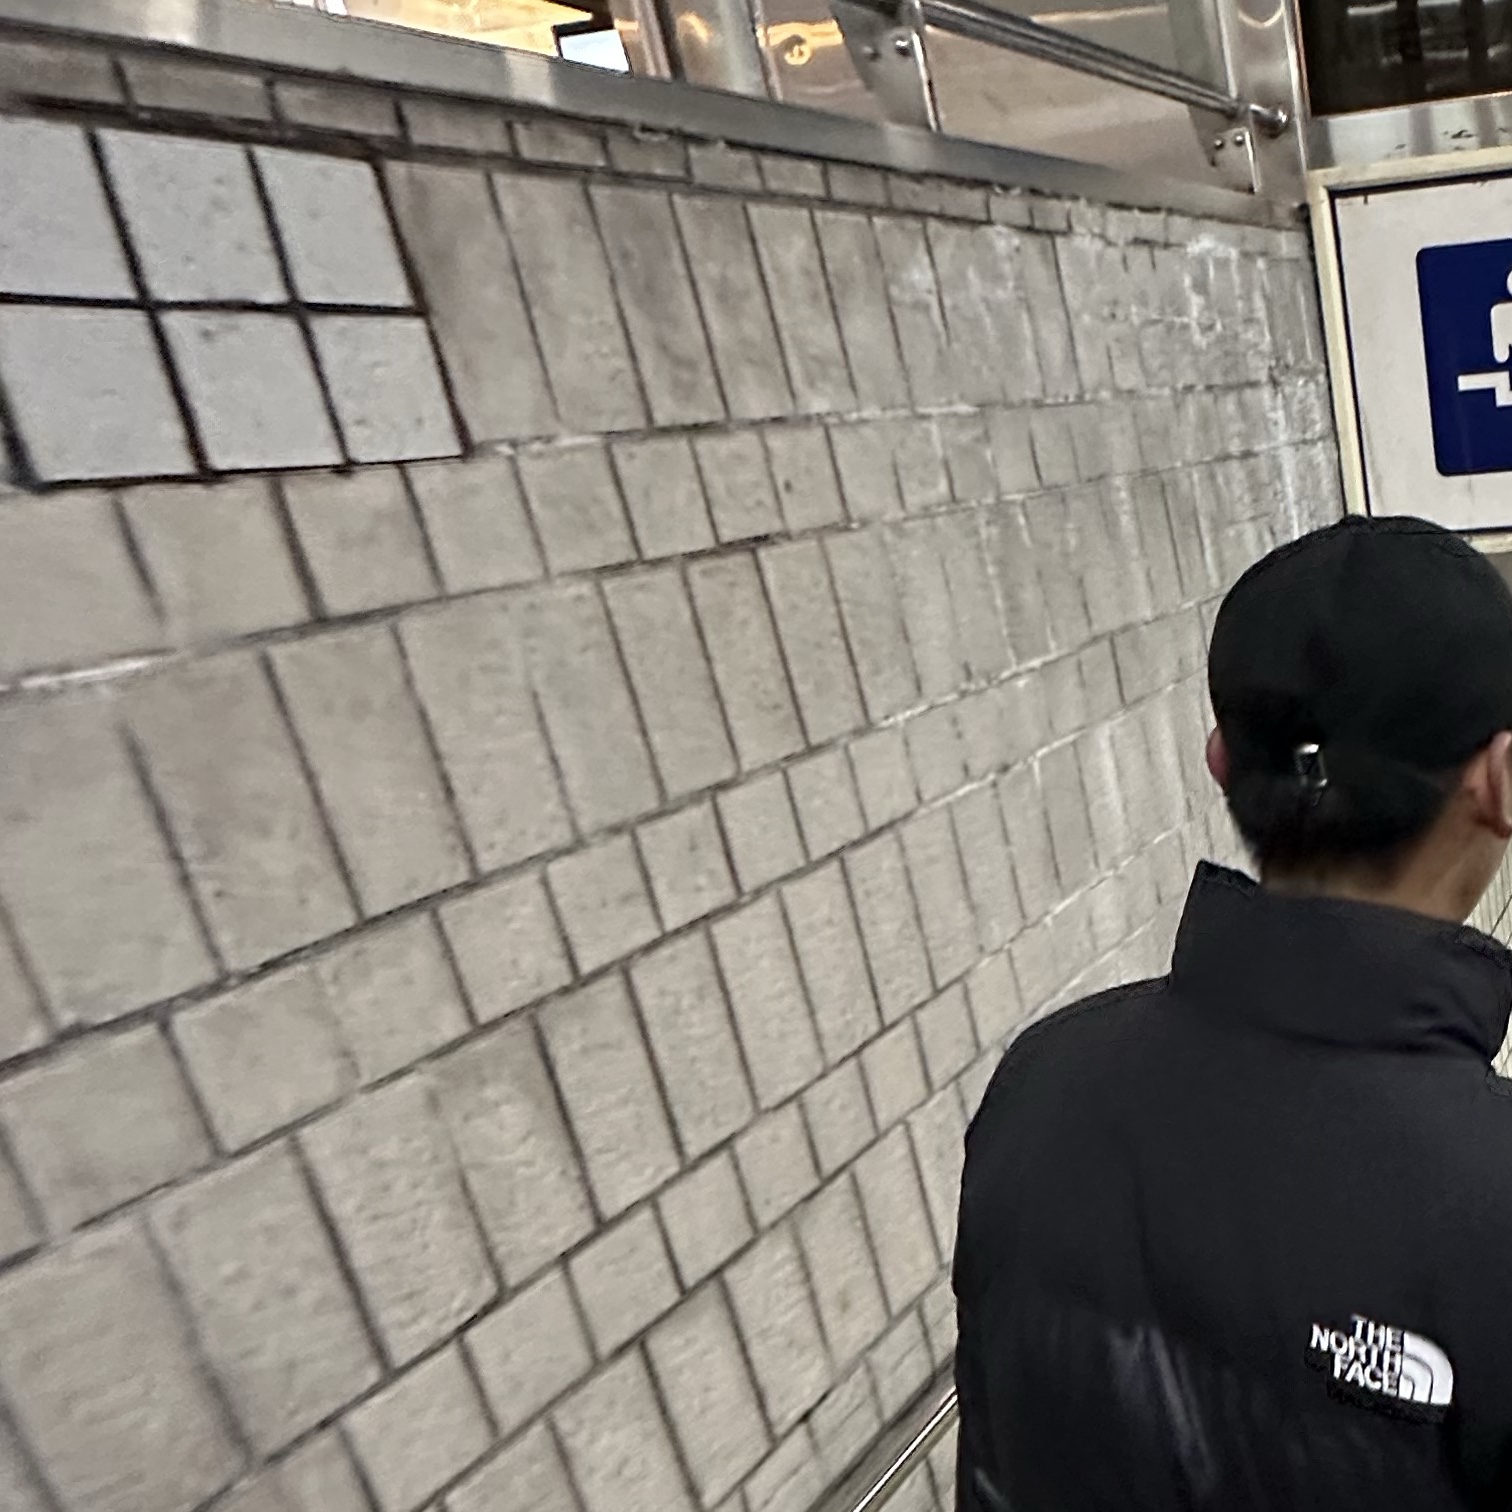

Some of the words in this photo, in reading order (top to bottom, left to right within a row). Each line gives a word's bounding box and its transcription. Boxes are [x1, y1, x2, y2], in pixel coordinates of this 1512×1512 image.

[1310, 1323, 1402, 1376] NORTH
[1351, 1313, 1402, 1351] THE
[1333, 1352, 1398, 1396] FACE
